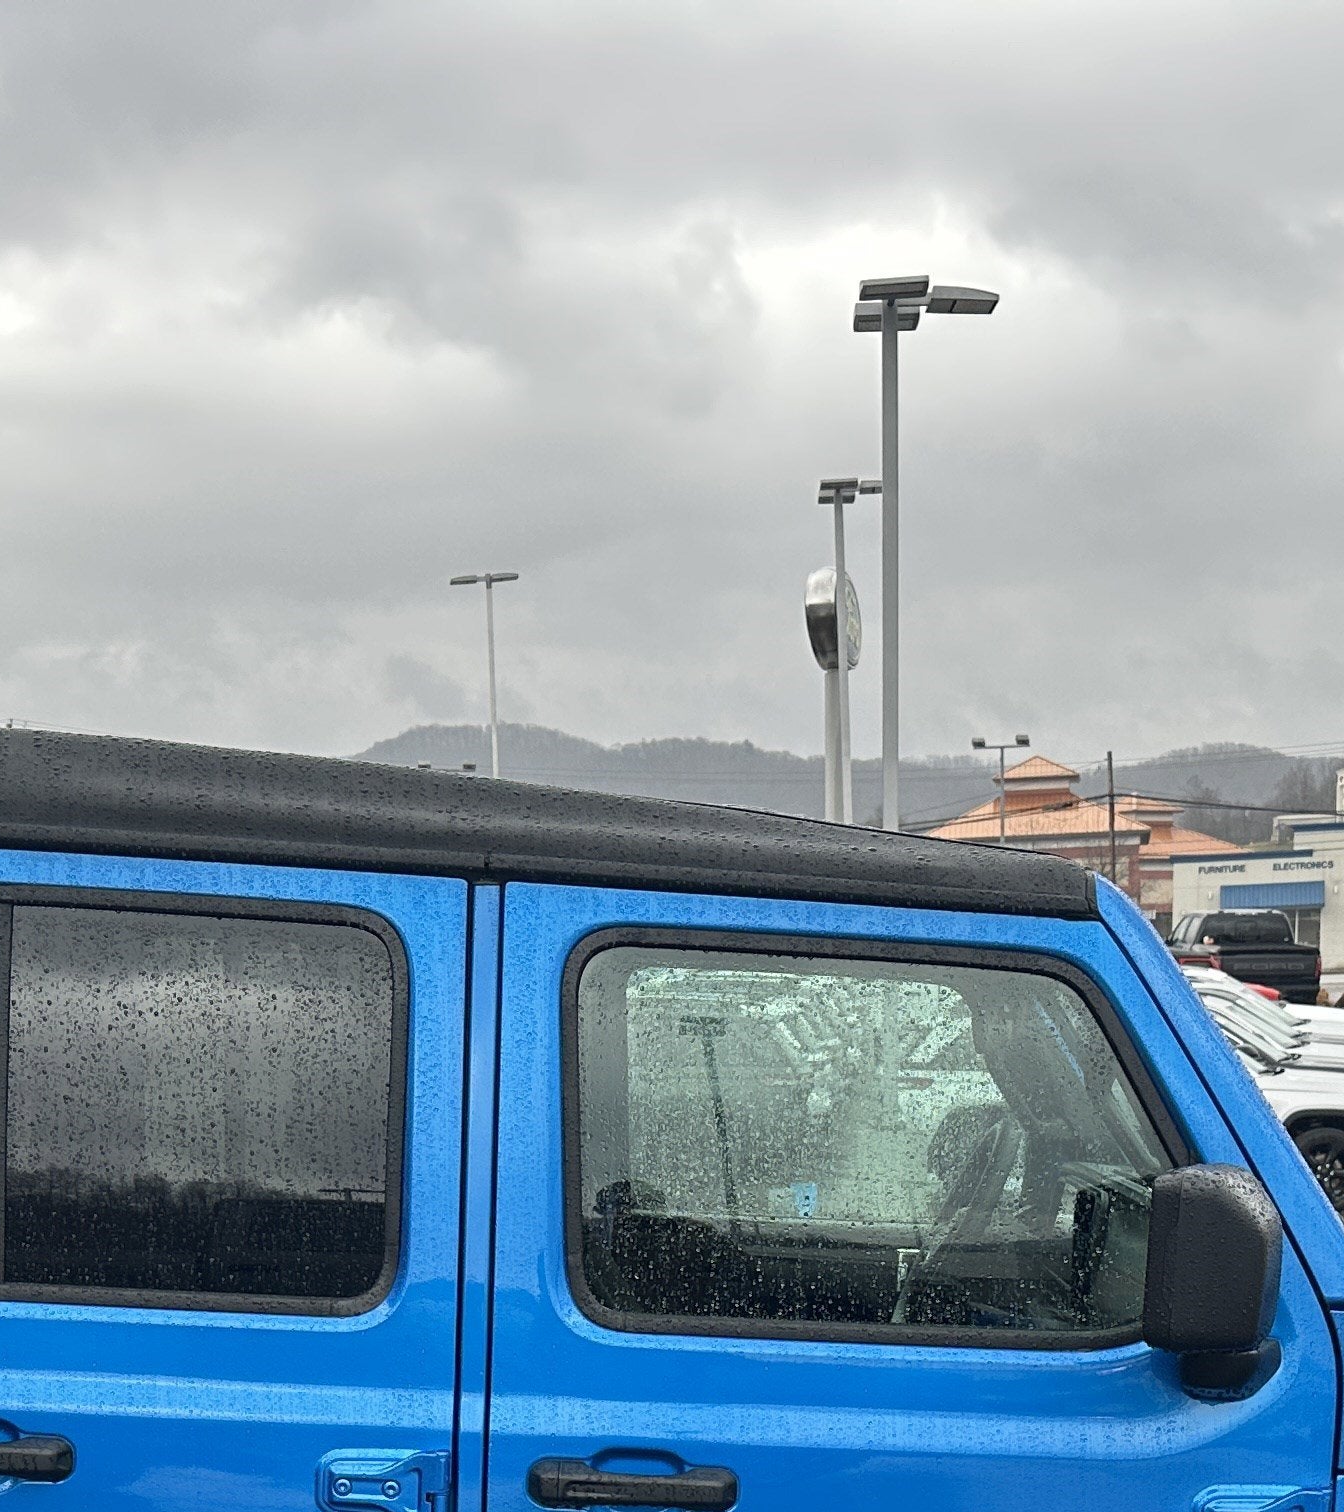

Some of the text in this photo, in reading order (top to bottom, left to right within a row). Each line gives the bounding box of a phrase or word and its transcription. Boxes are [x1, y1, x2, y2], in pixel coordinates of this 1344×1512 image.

[1198, 863, 1246, 875] FURNITURE
[1272, 860, 1334, 872] ELECTRONICS
[1233, 963, 1306, 971] FORD
